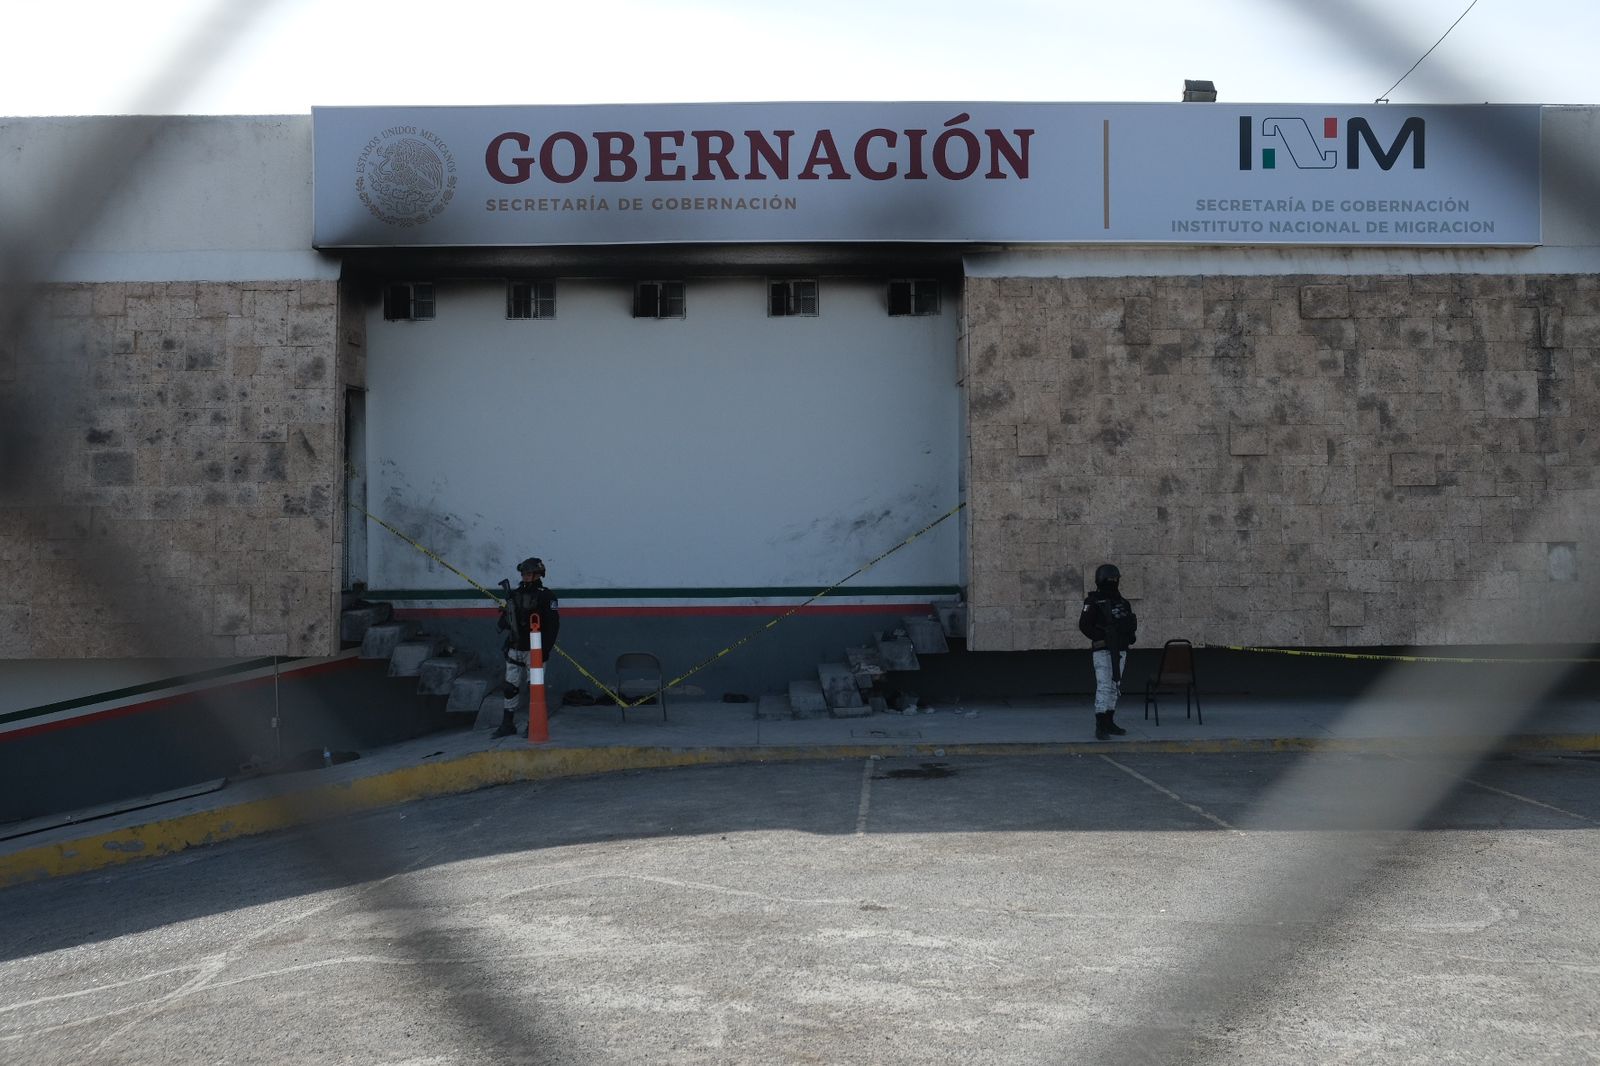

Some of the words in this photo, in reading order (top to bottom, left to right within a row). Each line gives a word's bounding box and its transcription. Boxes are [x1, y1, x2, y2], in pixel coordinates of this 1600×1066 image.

[356, 136, 380, 174] ESTADOS
[381, 126, 417, 139] UNIDOS
[420, 129, 457, 173] MEXICANOS
[485, 112, 1035, 184] GOBERNACIÓN
[1239, 116, 1425, 171] INM
[486, 195, 609, 212] SECRETARÍA
[618, 198, 644, 212] DE
[652, 194, 797, 211] GOBERNACIÓN
[1196, 196, 1307, 212] SECRETARÍA
[1311, 199, 1335, 212] DE
[1340, 196, 1470, 213] GOBERNACIÓN
[1172, 220, 1263, 234] INSTITUTO
[1269, 220, 1360, 234] NACIONAL
[1366, 220, 1389, 234] DE
[1395, 220, 1495, 234] MIGRACION
